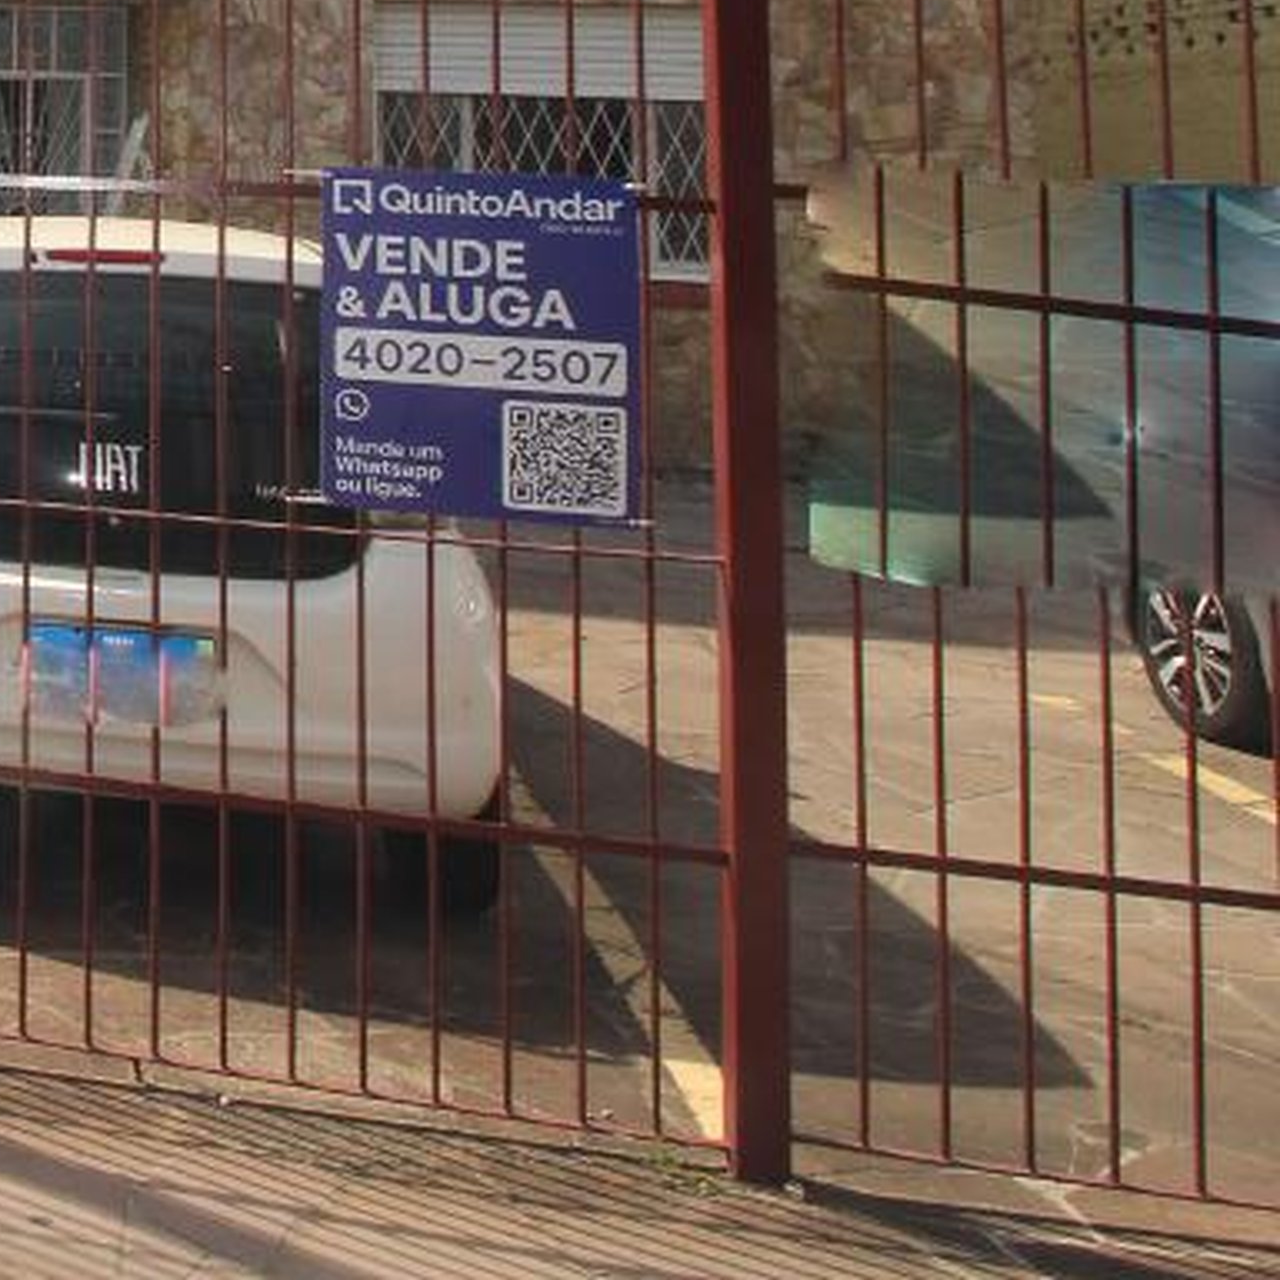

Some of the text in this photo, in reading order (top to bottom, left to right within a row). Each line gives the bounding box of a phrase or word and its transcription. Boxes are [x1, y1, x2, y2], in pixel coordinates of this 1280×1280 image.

[380, 184, 623, 222] QuintoAndar
[336, 233, 527, 280] VENDE
[336, 281, 576, 330] & ALUGA
[344, 338, 619, 386] 4020-2507
[335, 478, 361, 493] ou
